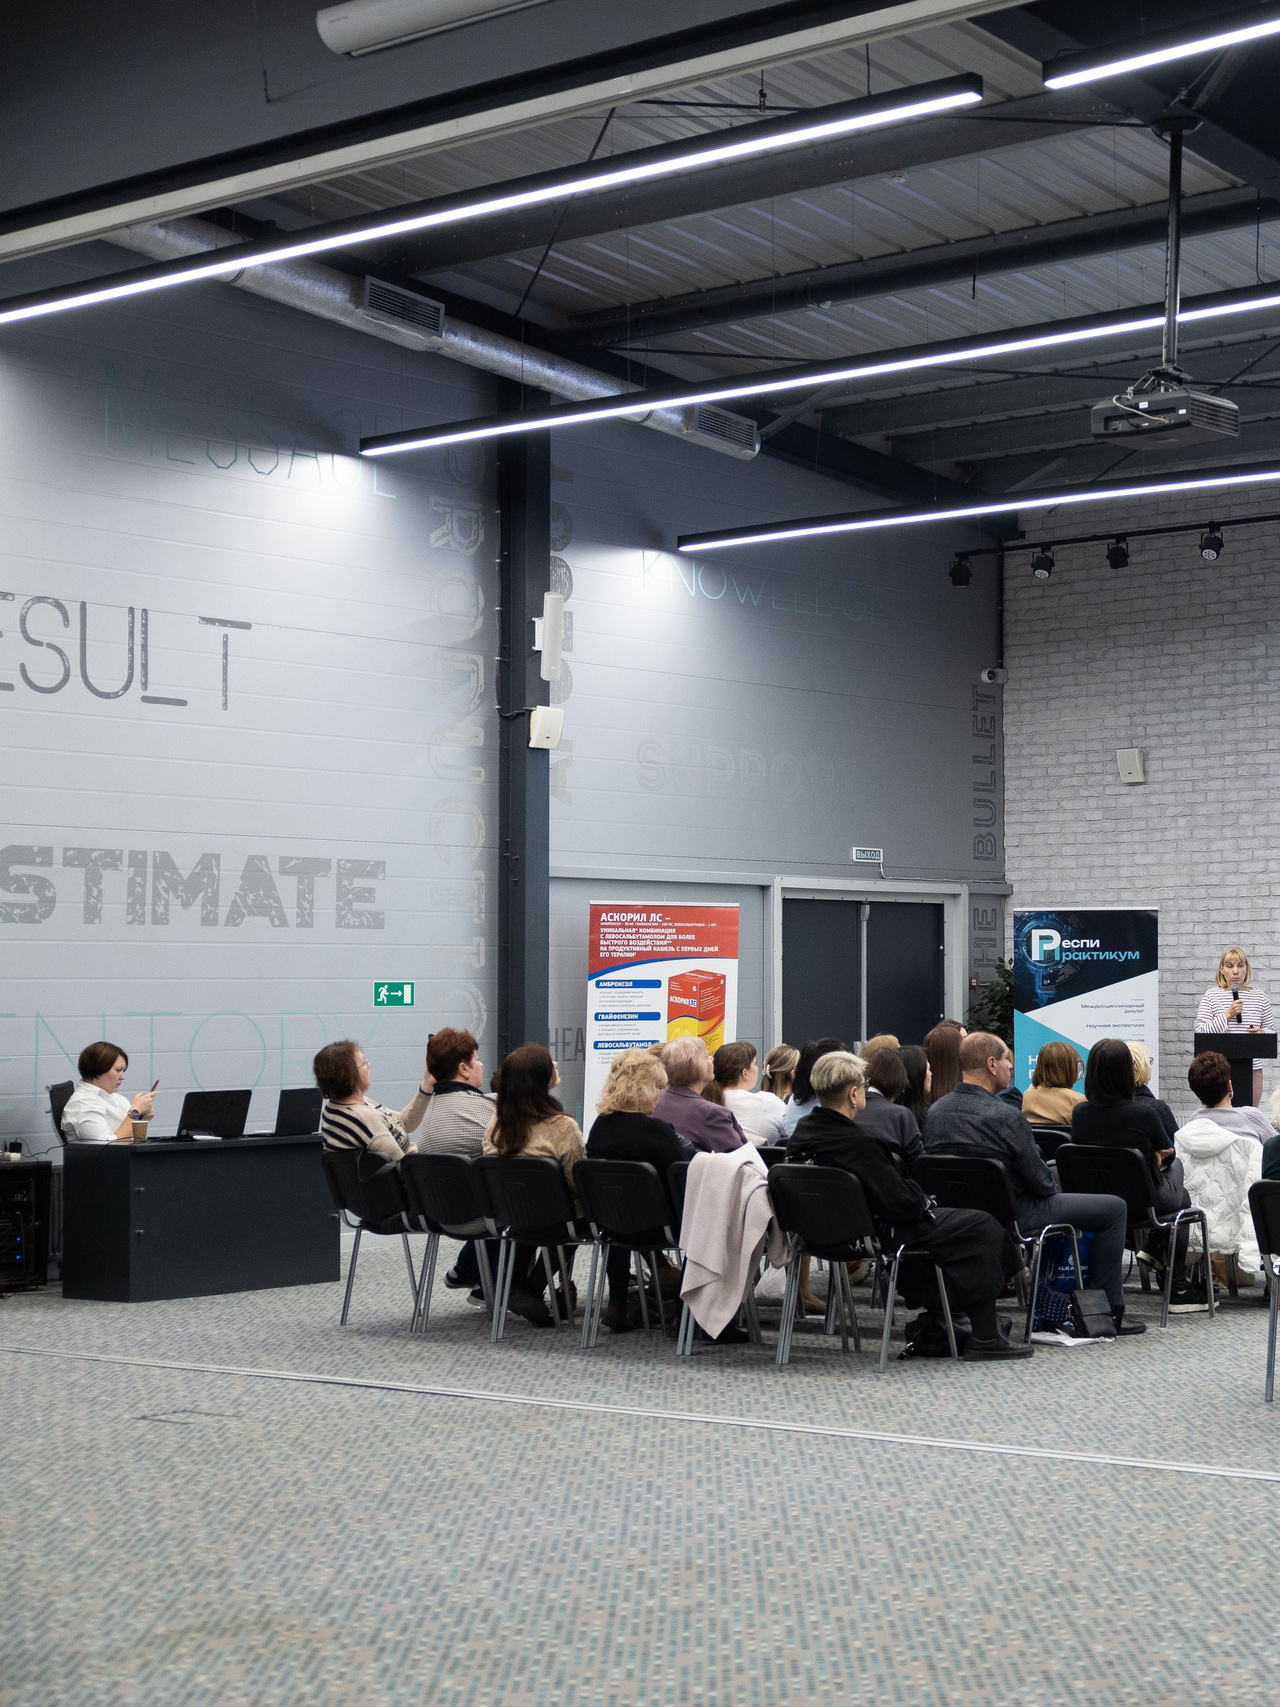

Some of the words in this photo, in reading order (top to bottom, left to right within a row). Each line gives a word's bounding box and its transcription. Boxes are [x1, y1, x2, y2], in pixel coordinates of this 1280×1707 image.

[642, 550, 887, 626] KNOWLEDGE
[972, 684, 997, 862] BULLET
[857, 851, 879, 860] ВЫХОД
[600, 913, 647, 922] АСКОРИЛ
[649, 913, 663, 922] ЛС
[670, 996, 689, 1006] АСКОРИЛ
